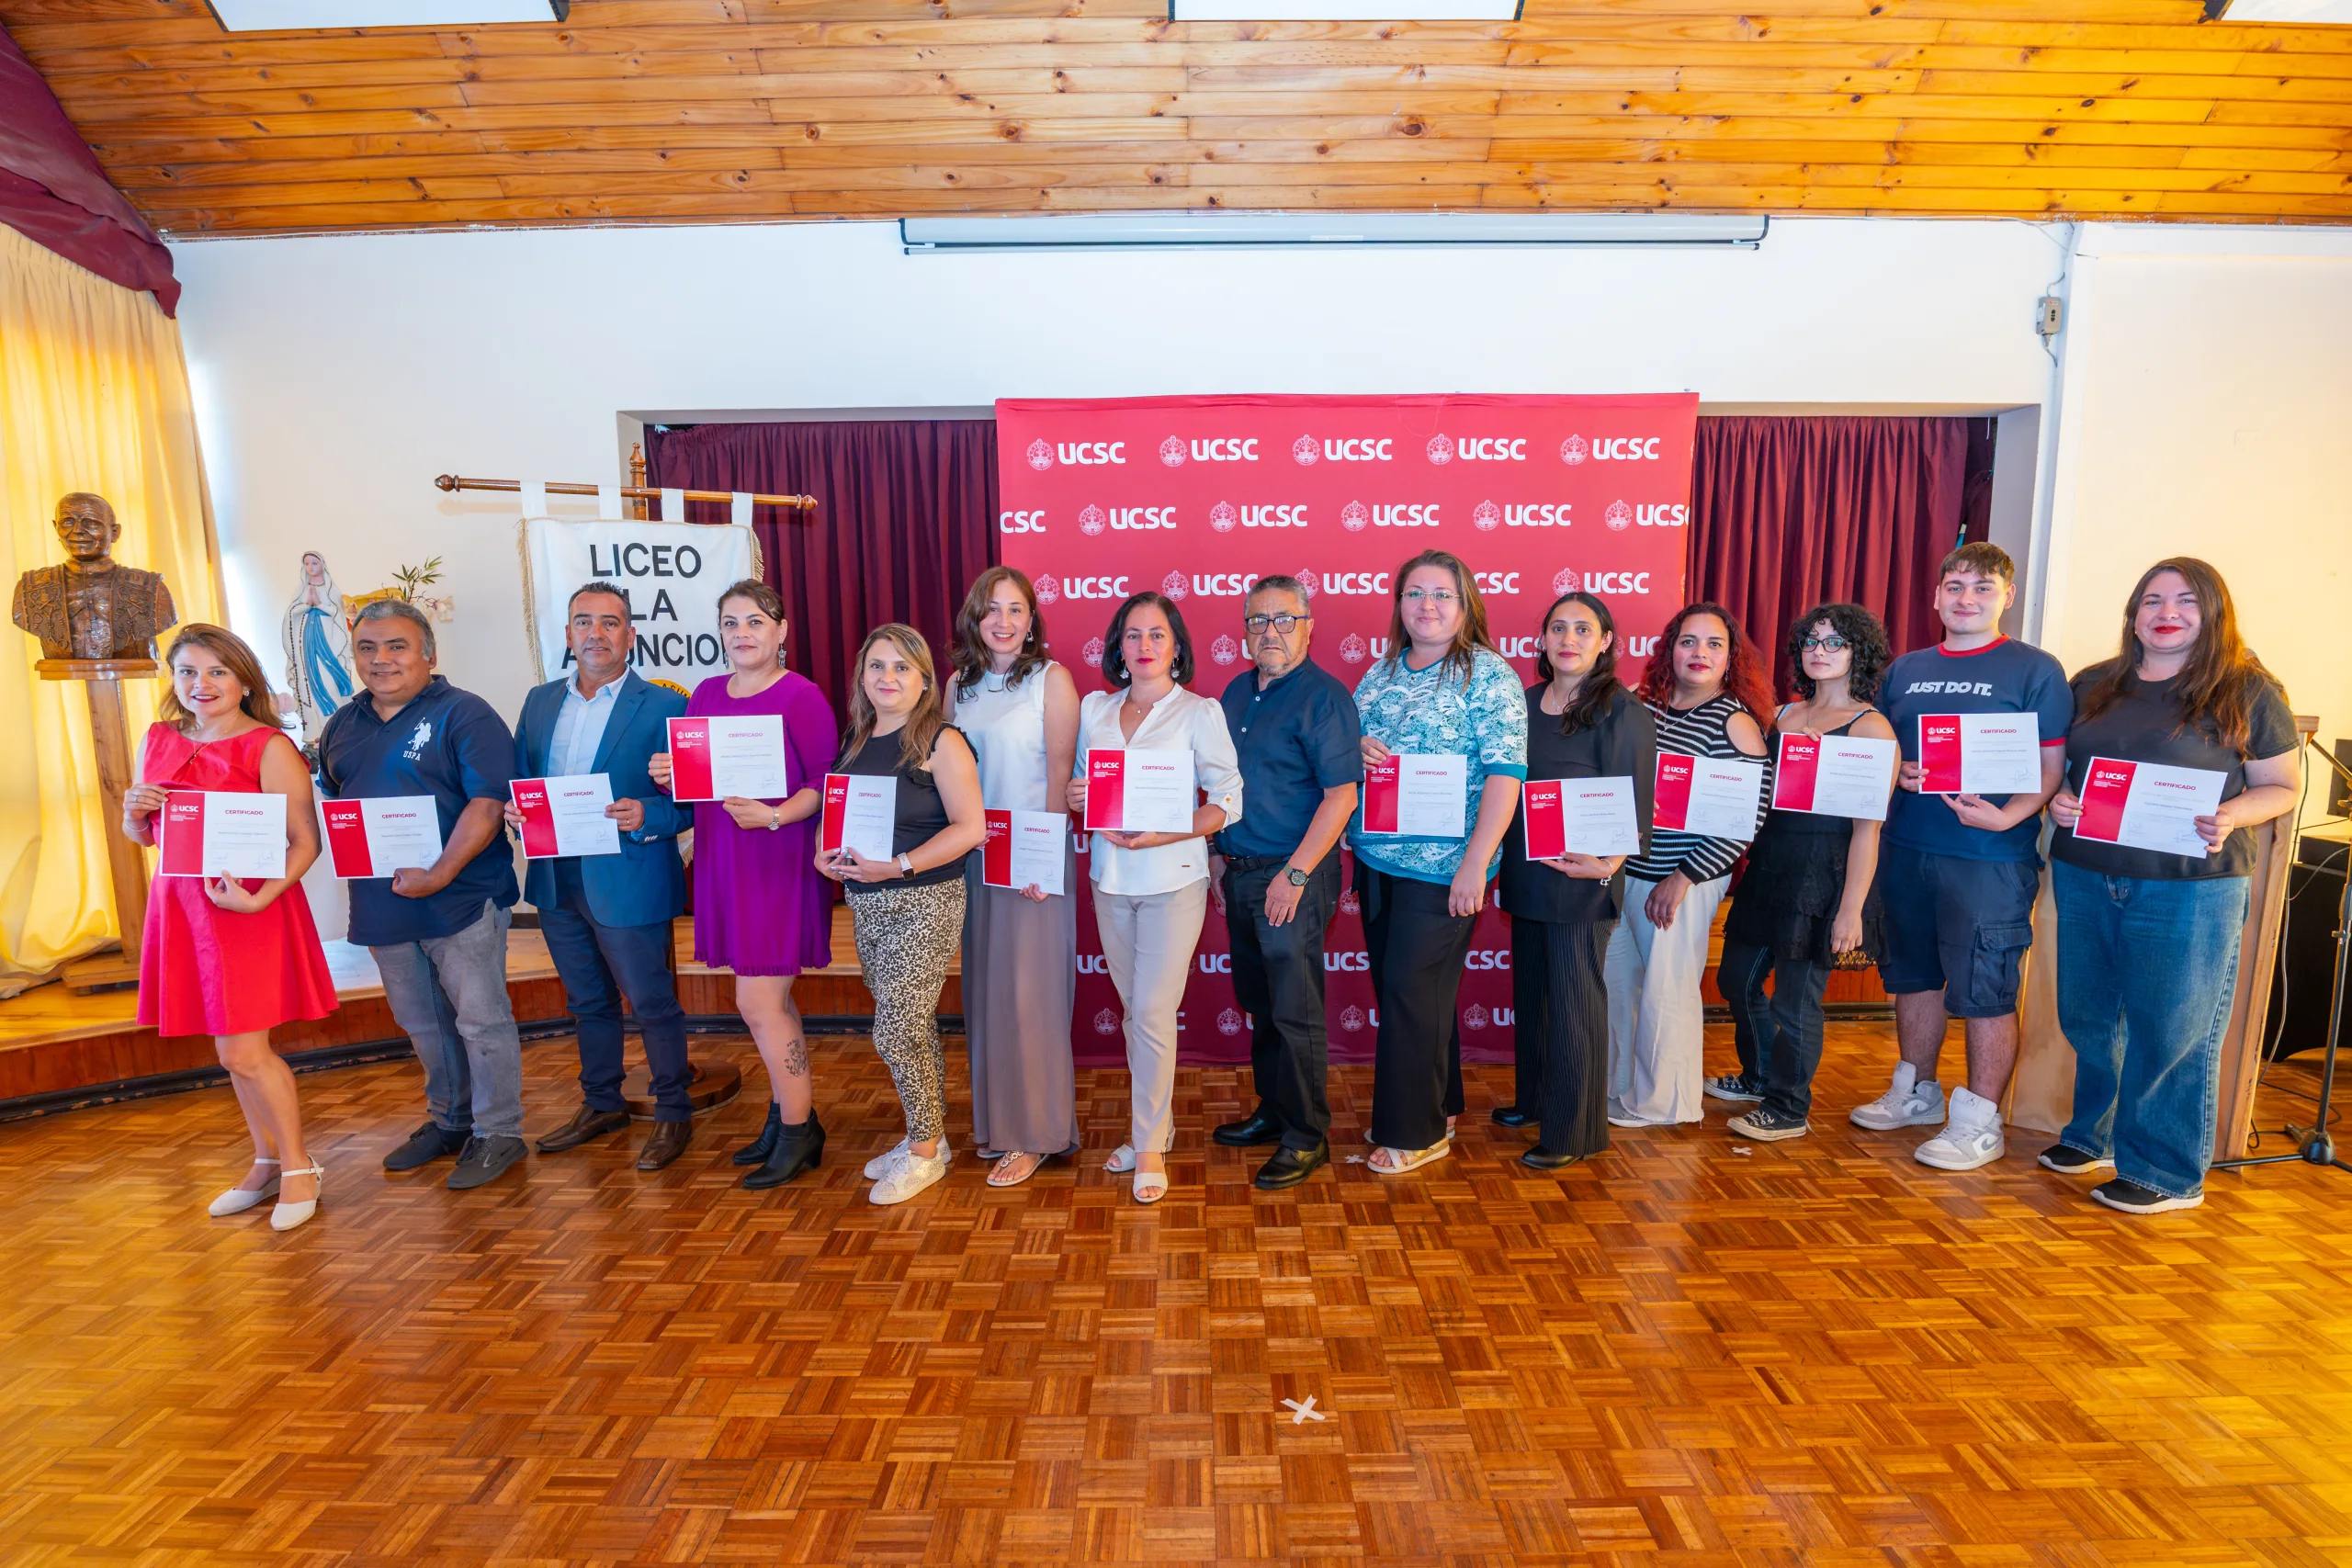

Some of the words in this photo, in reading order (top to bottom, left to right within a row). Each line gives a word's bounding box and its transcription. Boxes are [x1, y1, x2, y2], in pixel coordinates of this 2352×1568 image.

[1058, 442, 1125, 464] UCSC
[1192, 439, 1258, 460] UCSC
[1325, 439, 1392, 460] UCSC
[1459, 438, 1526, 460] UCSC
[1593, 438, 1660, 459] UCSC
[1001, 511, 1046, 533] CSC
[1110, 507, 1176, 529] UCSC
[1241, 505, 1307, 526] UCSC
[1374, 504, 1440, 526] UCSC
[1636, 504, 1689, 526] UCS
[590, 543, 702, 579] LICEO
[1064, 577, 1129, 599] UCSC
[1193, 574, 1258, 595] UCSC
[1324, 573, 1388, 594] UCSC
[1474, 572, 1519, 593] CSC
[1584, 572, 1649, 593] UCSC
[623, 589, 678, 621] LA
[1500, 637, 1542, 658] UC
[1629, 636, 1661, 658] UC
[1905, 682, 1945, 694] JUST
[1944, 682, 1972, 694] DO
[1973, 682, 1992, 696] IT.
[403, 750, 421, 761] USPA
[1795, 746, 1815, 754] UCSC
[1838, 751, 1873, 760] CERTIFICADO
[1670, 766, 1689, 774] UCSC
[1709, 773, 1743, 782] CERTIFICADO
[2105, 772, 2128, 781] UCSC
[2154, 781, 2197, 791] CERTIFICADO
[178, 805, 199, 813] UCSC
[992, 821, 1008, 829] UCSC
[1077, 954, 1108, 974] UC
[1200, 953, 1232, 974] UC
[1324, 952, 1370, 971] UCS
[1464, 950, 1510, 970] CSC
